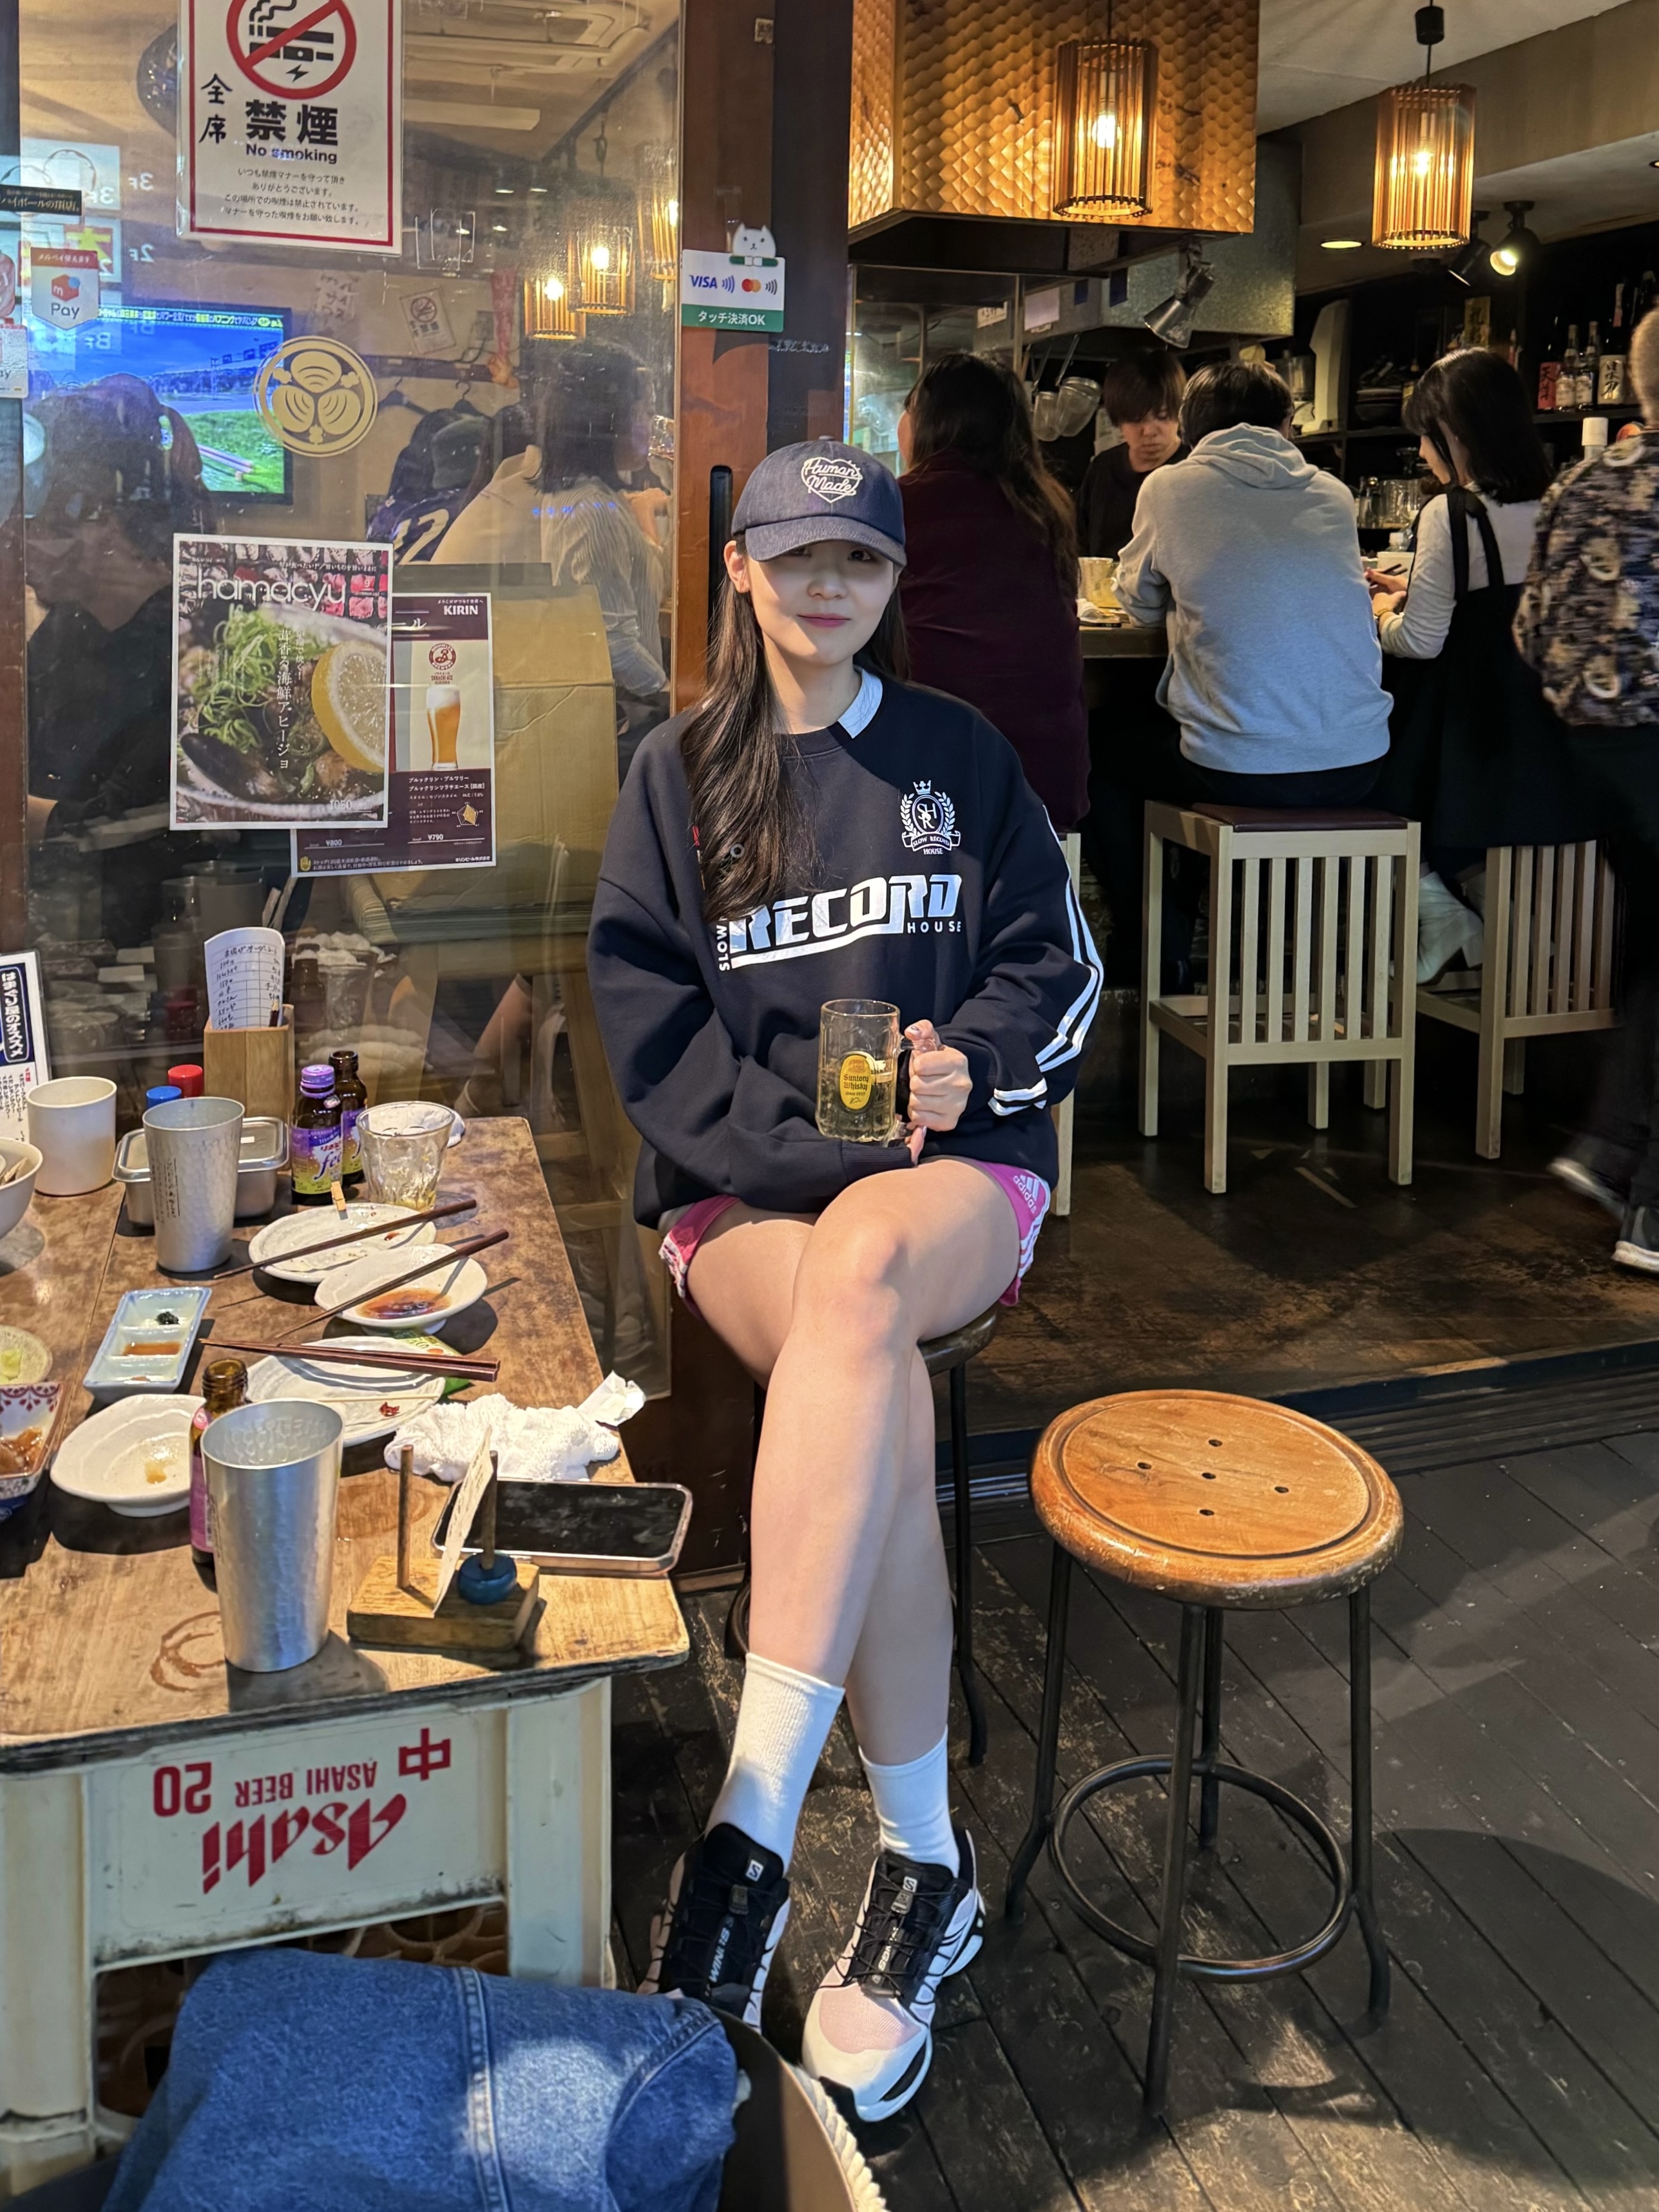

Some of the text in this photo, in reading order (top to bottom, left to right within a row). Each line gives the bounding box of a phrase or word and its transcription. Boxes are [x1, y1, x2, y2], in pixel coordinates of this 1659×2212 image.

[198, 73, 233, 144] 全席
[245, 99, 338, 146] 禁煙
[246, 144, 337, 164] No smoking
[252, 183, 332, 197] ありがとうございます。
[689, 275, 718, 289] VISA
[51, 303, 80, 319] Pay
[698, 311, 765, 325] タッチ決済OK
[804, 458, 859, 476] Human
[807, 475, 854, 493] Made
[198, 564, 346, 611] hamacyu
[444, 605, 478, 615] KIRIN
[912, 836, 950, 847] SLOW RECORD
[729, 874, 962, 961] RECORD
[907, 920, 961, 933] HOUSE
[843, 1074, 869, 1083] Suntory
[843, 1082, 868, 1091] Whisky
[399, 1728, 451, 1781] 中
[153, 1762, 212, 1818] 20
[235, 1761, 378, 1808] ASAHI BEER
[203, 1793, 407, 1895] Asahi
